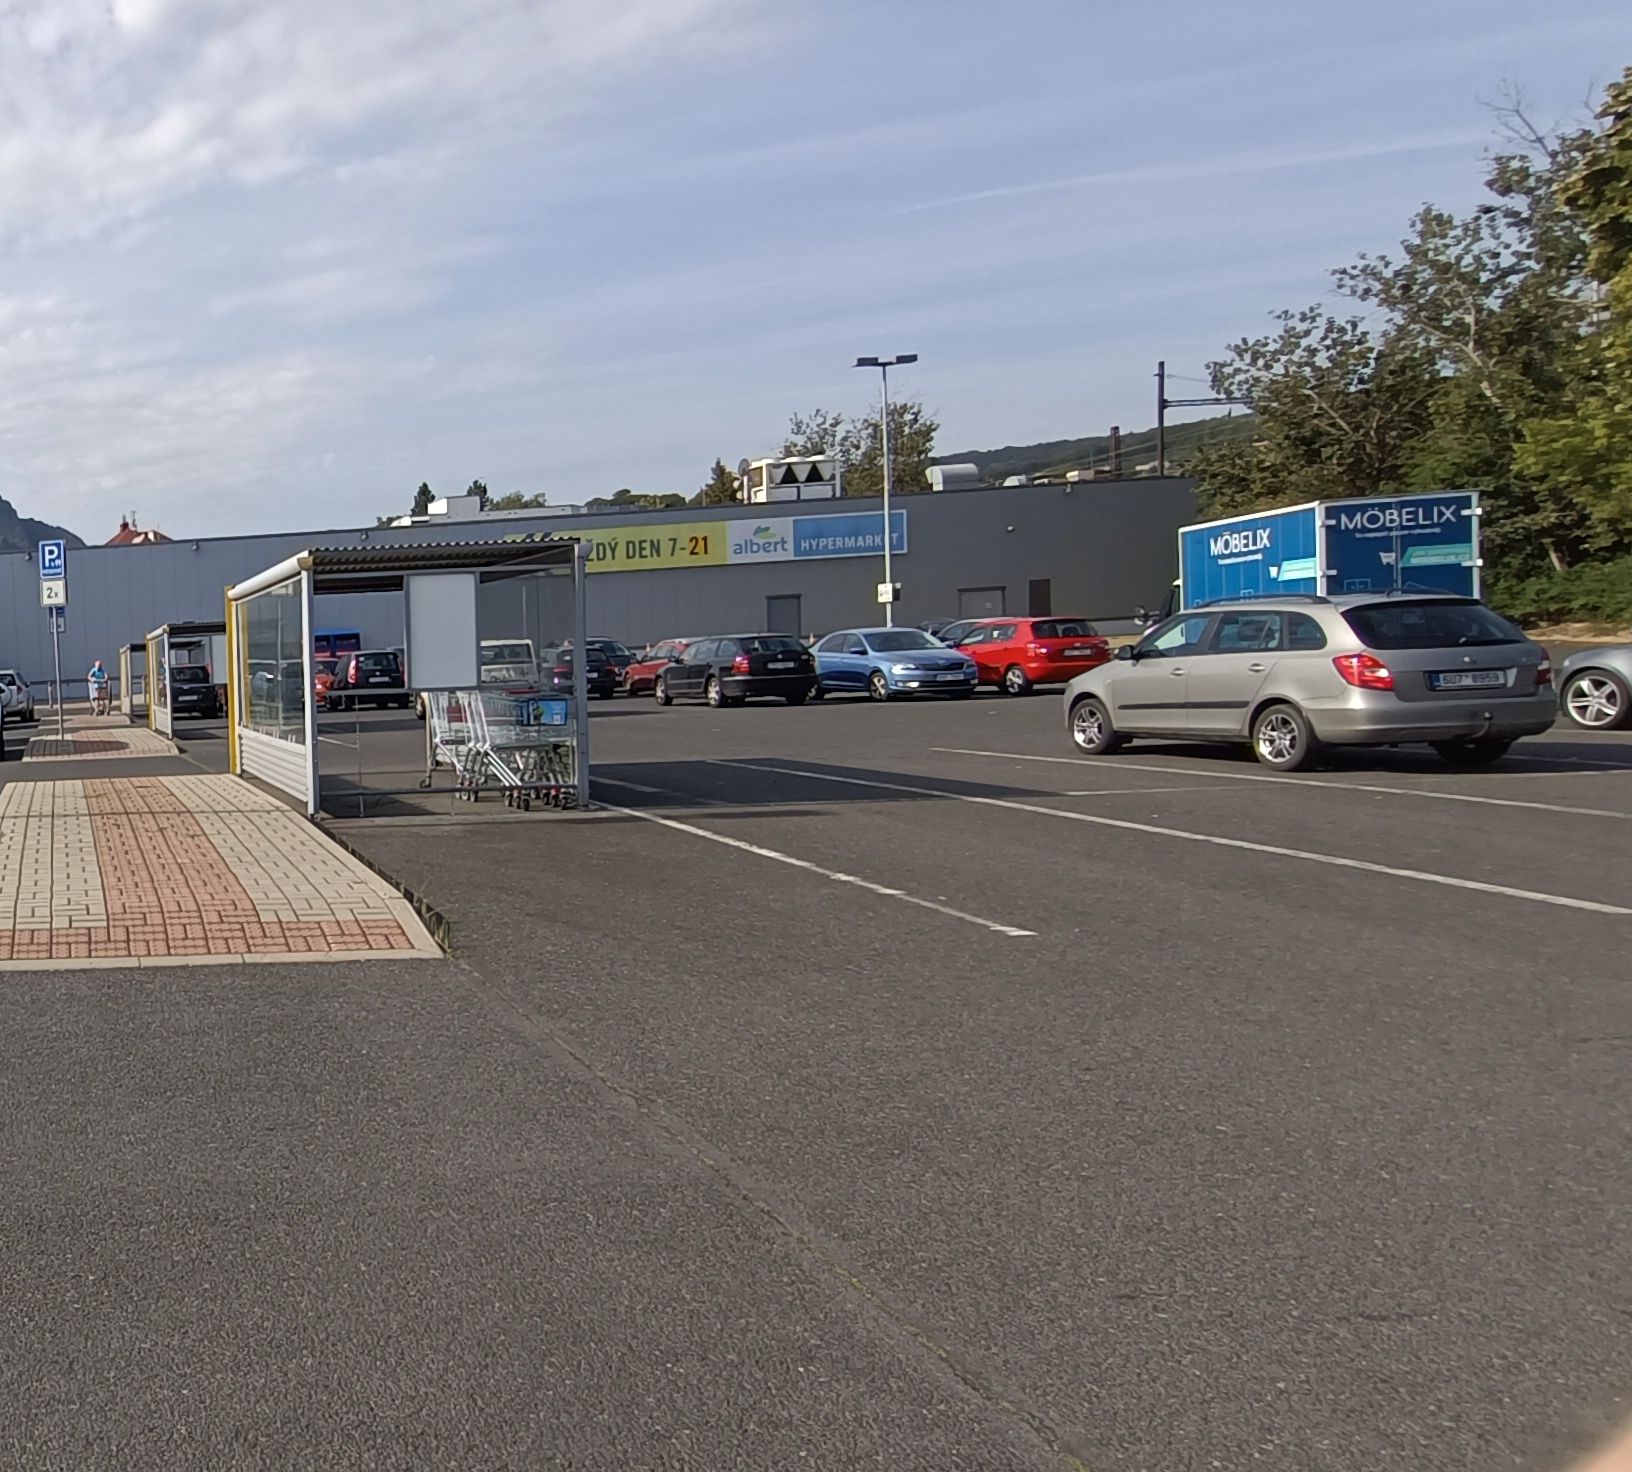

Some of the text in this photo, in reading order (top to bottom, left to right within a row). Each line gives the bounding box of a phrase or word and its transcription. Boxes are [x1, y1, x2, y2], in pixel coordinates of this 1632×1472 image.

[1340, 504, 1458, 531] MÖBELIX
[585, 537, 620, 563] ŽDÝ
[625, 538, 661, 560] DEN
[733, 533, 899, 555] albert HYPERMARKT
[1210, 527, 1272, 557] MÖBELIX
[44, 545, 58, 567] P
